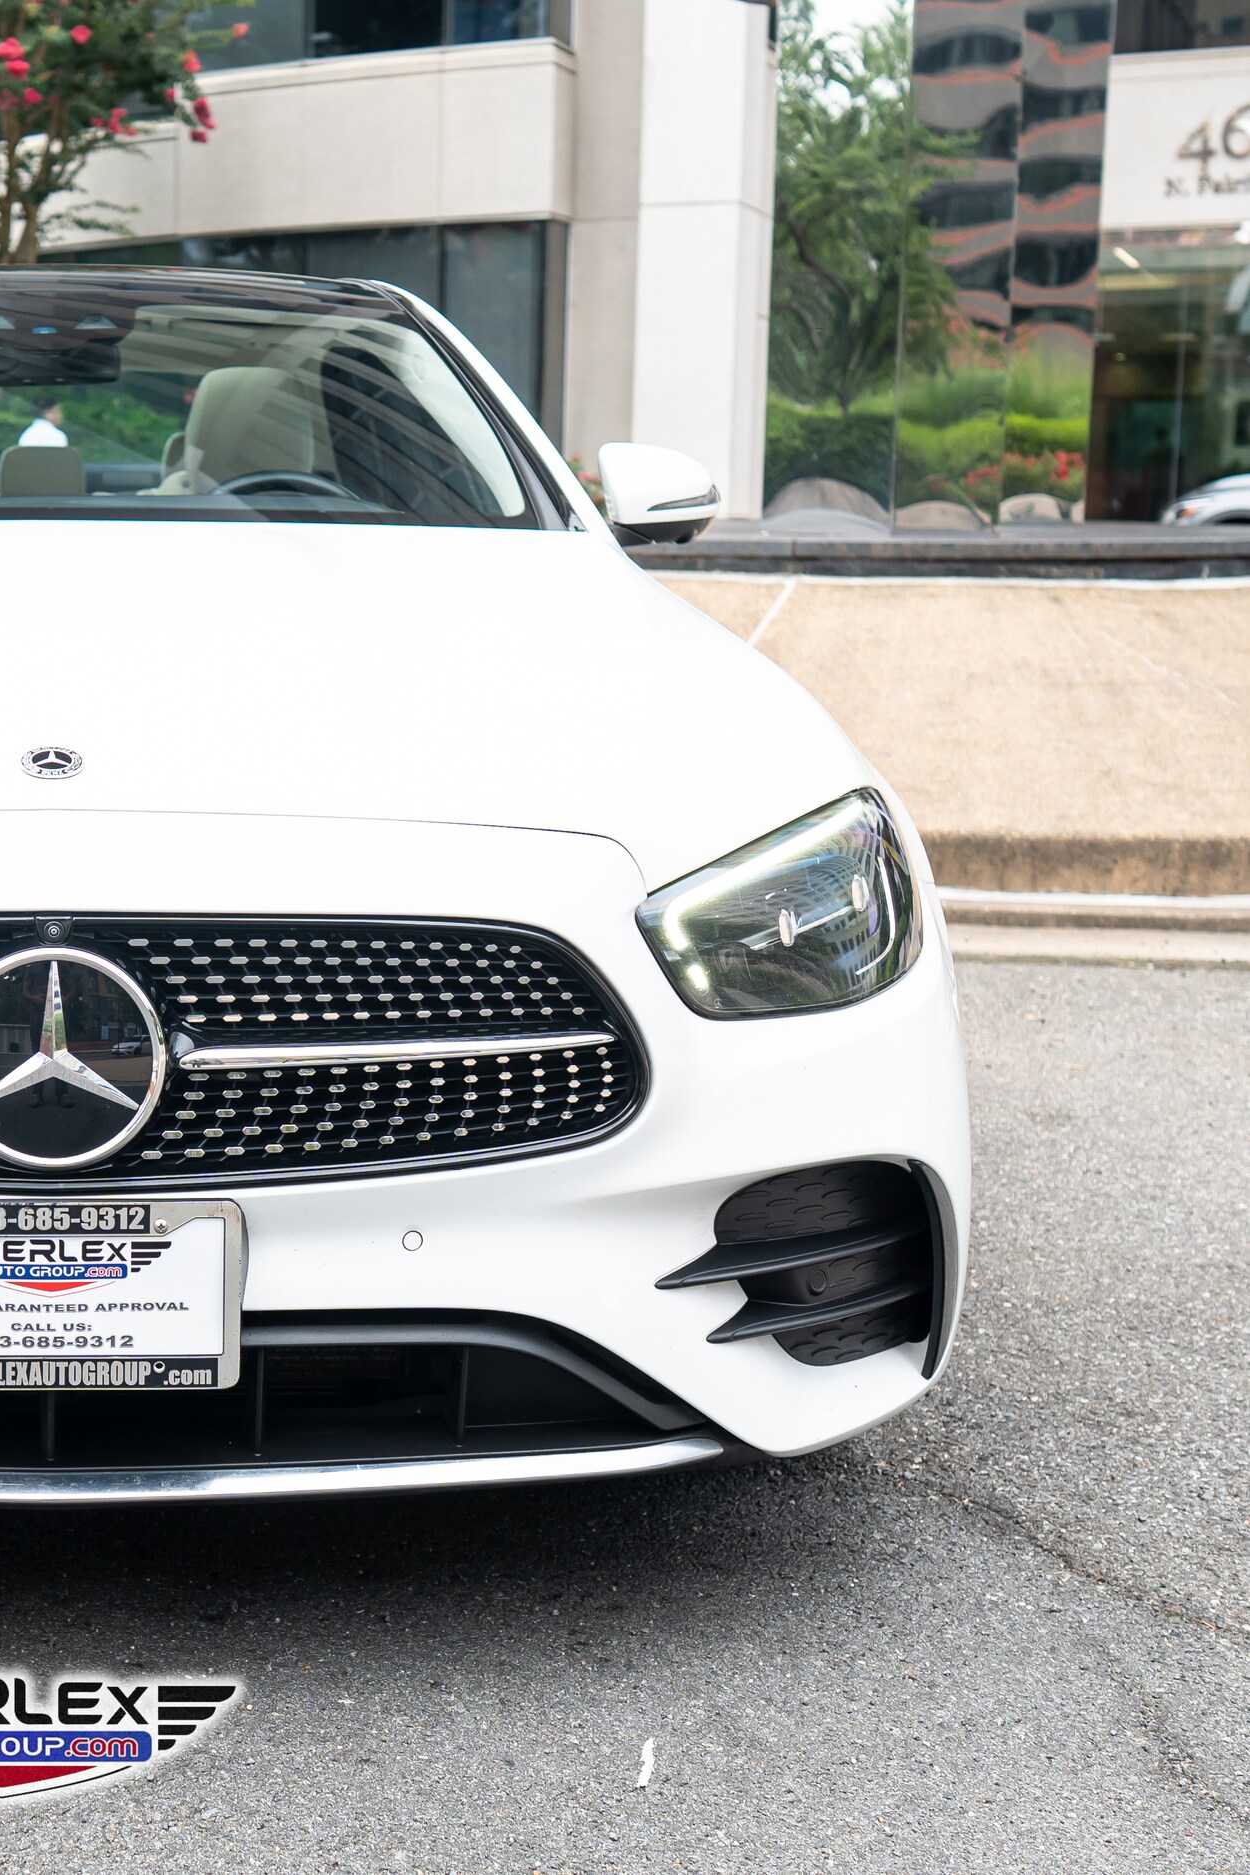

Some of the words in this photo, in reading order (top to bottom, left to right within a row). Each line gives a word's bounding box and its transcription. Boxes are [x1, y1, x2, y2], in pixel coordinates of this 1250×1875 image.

[29, 1265, 123, 1278] GROUP.com
[94, 1302, 189, 1312] APPROVAL
[11, 1322, 57, 1332] CALL
[62, 1322, 92, 1332] US:
